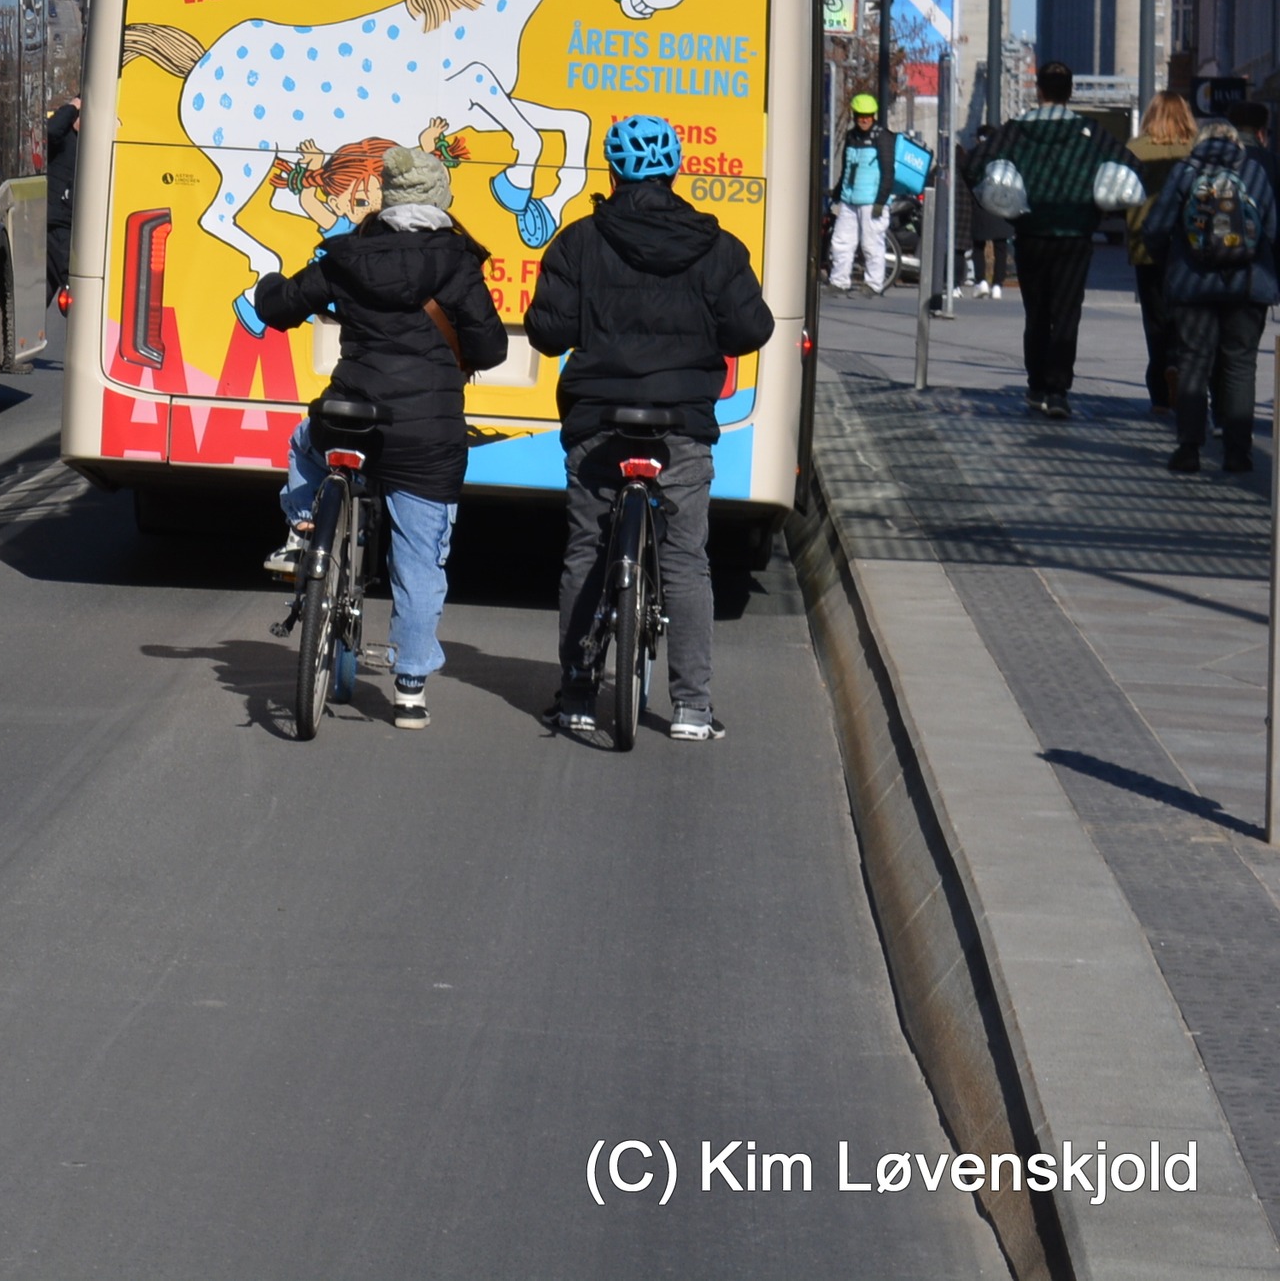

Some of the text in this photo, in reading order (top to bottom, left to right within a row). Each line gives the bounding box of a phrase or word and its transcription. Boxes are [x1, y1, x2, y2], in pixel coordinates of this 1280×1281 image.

[567, 20, 758, 64] ÅRETS BØRNE-
[566, 62, 750, 98] FORESTILLING
[691, 176, 763, 204] 6029
